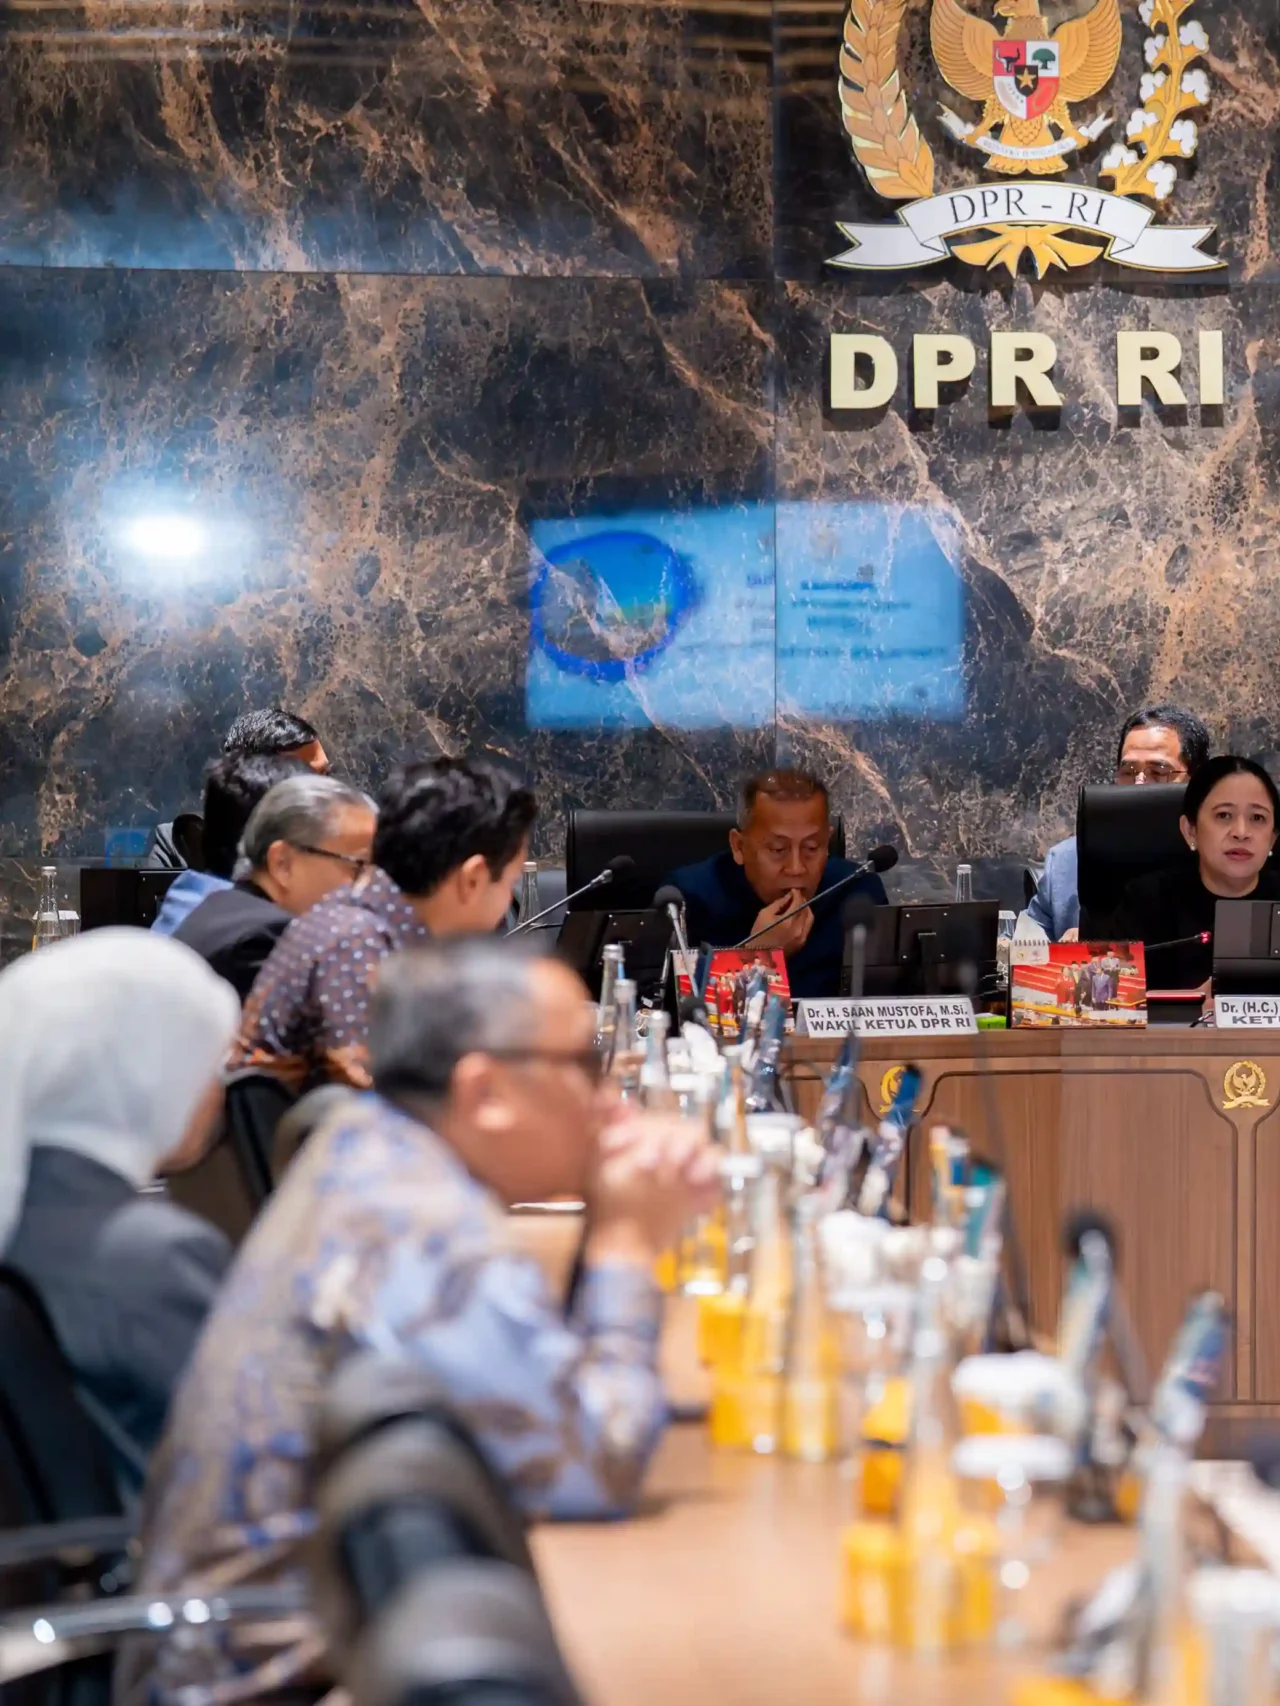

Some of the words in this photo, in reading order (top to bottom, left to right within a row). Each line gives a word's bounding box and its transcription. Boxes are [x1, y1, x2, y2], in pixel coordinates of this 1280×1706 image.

[948, 188, 1028, 225] DPR
[1065, 190, 1107, 226] RI
[830, 331, 1063, 410] DPR
[1117, 330, 1224, 407] RI
[807, 1008, 824, 1018] Dr.
[828, 1007, 840, 1018] H.
[843, 1006, 875, 1018] SAAN
[878, 1005, 938, 1018] MUSTOFA,
[940, 1004, 968, 1016] M.Si.
[1221, 1002, 1238, 1012] Dr.
[1242, 1002, 1278, 1015] (H.C.)
[810, 1019, 861, 1031] WAKIL
[865, 1018, 917, 1030] KETUA
[921, 1018, 951, 1029] DPR
[955, 1017, 971, 1028] RI
